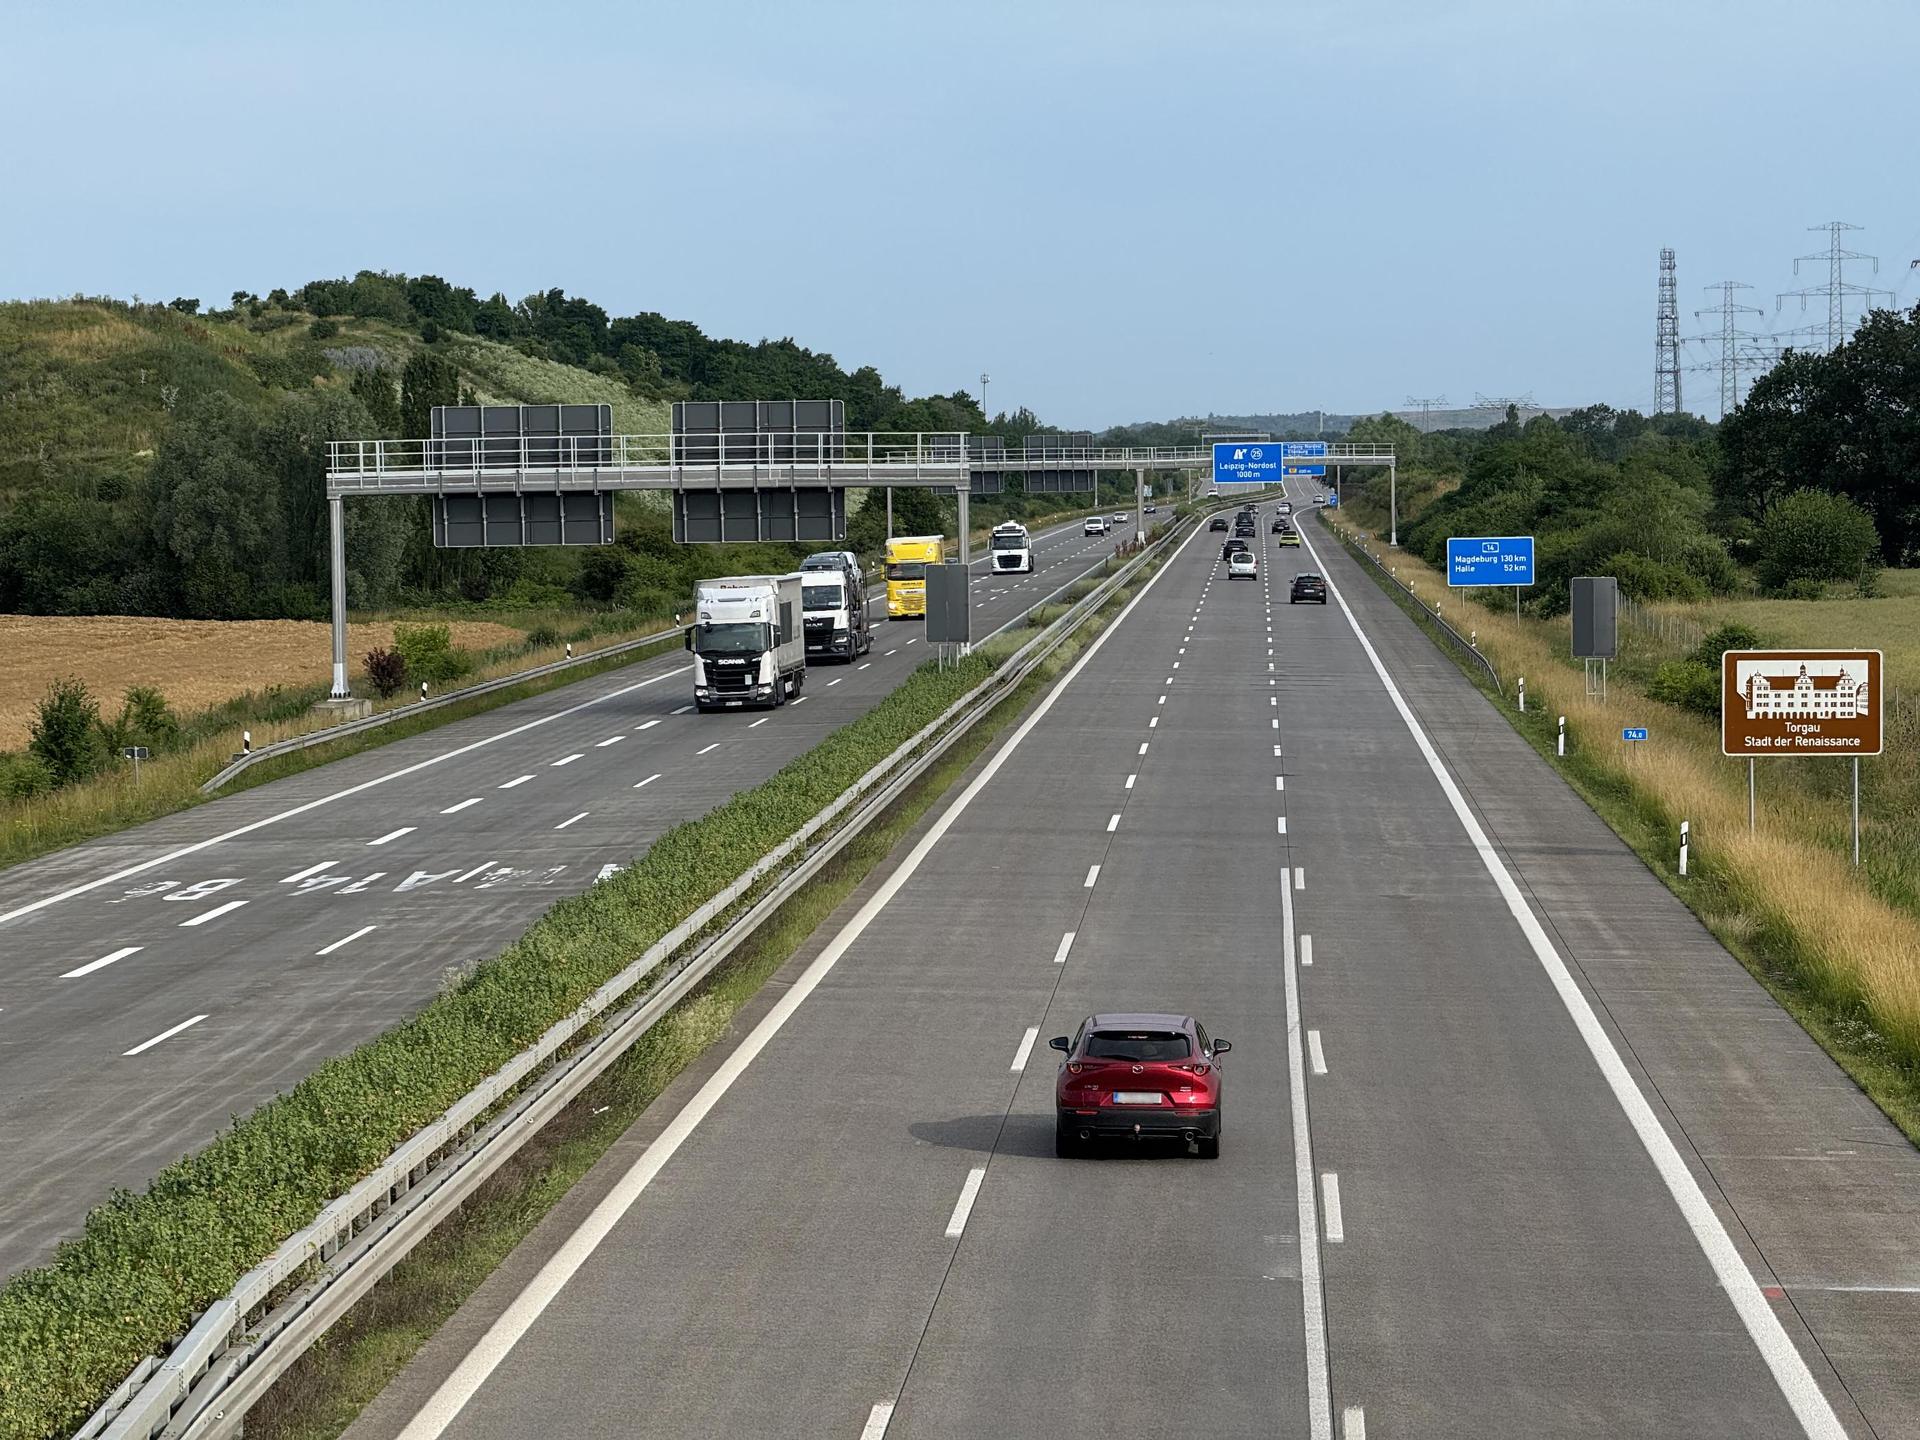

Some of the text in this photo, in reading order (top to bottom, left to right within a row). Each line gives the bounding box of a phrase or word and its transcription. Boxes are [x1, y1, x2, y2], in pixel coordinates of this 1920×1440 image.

[1252, 450, 1261, 458] 25
[1219, 462, 1277, 471] Leipzig-Nordost
[1455, 554, 1527, 564] Magdeburg 130 km
[1455, 564, 1527, 573] Halle 52 km
[1784, 722, 1821, 735] Torgau
[1744, 736, 1861, 747] Stadt der Renaissance
